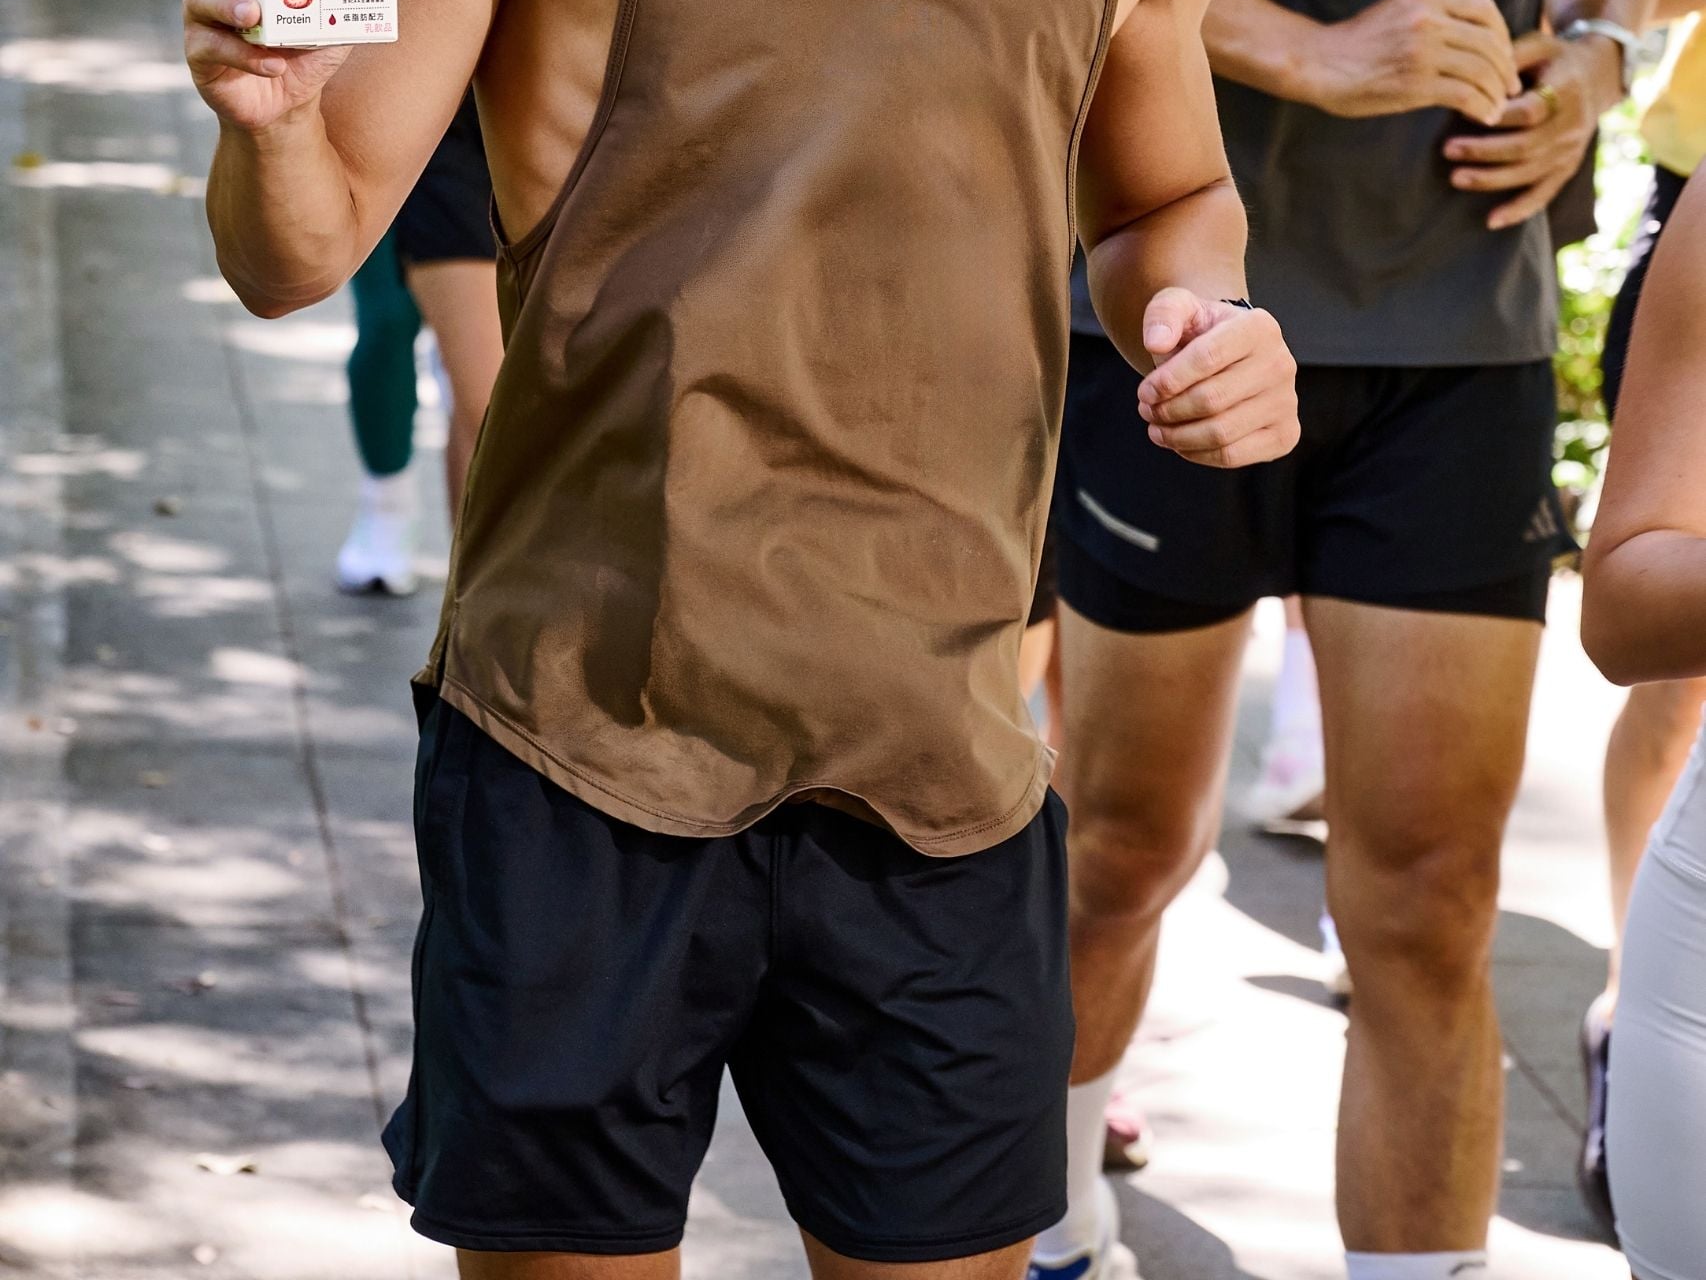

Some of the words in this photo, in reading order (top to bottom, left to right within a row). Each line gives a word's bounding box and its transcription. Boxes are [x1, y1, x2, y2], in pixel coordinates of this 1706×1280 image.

[276, 13, 311, 25] Protein
[343, 13, 384, 22] 低脂肪配方
